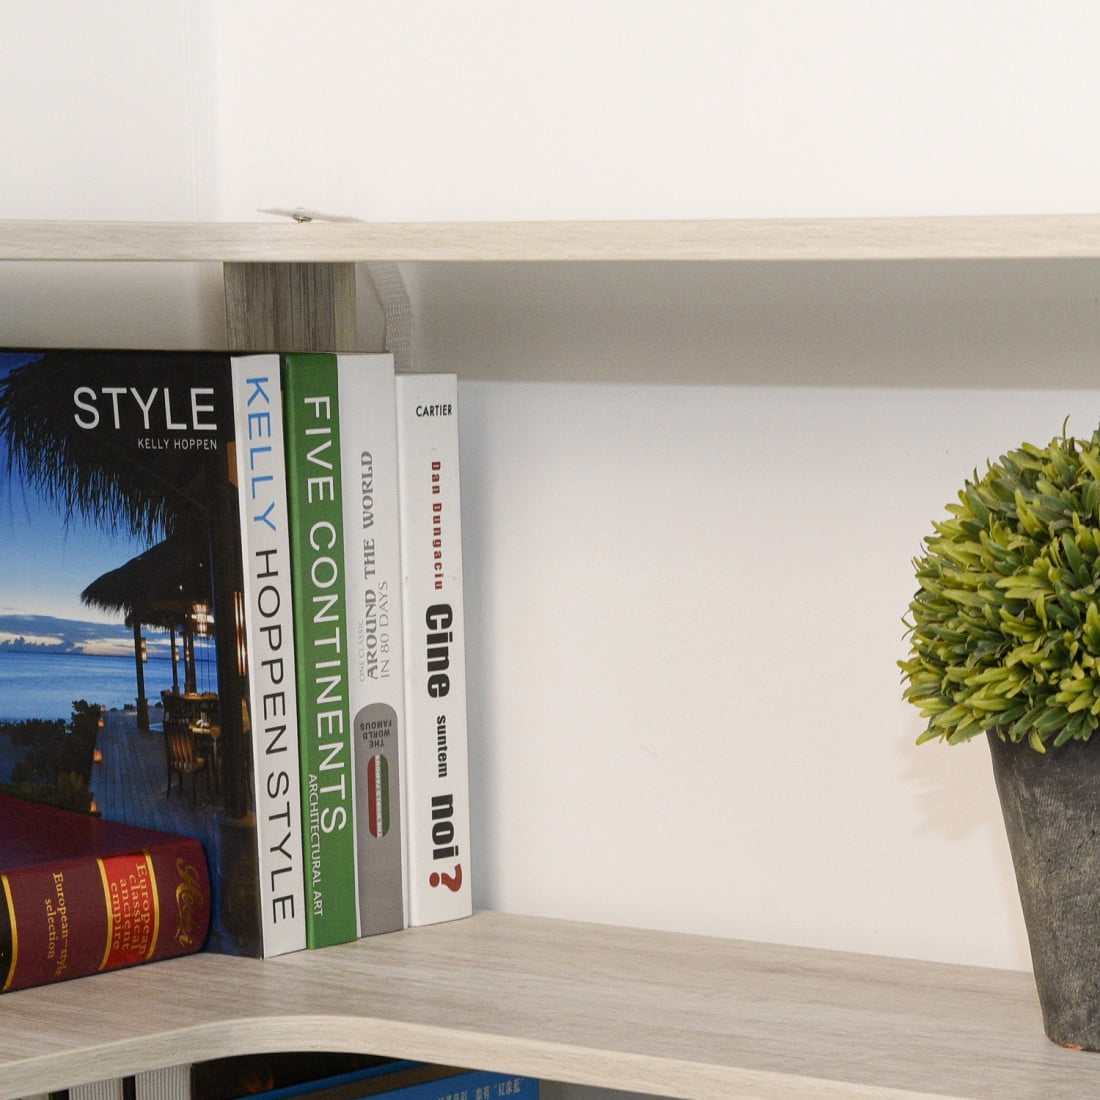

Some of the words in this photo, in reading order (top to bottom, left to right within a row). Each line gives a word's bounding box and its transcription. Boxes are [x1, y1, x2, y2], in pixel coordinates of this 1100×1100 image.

[73, 386, 217, 431] STYLE
[416, 404, 453, 417] CARTIER
[137, 438, 170, 450] KELLY
[173, 438, 217, 450] HOPPEN
[245, 376, 277, 532] KELLY
[304, 396, 335, 504] FIVE
[361, 451, 374, 529] WORLD
[431, 461, 441, 494] Dan
[363, 538, 376, 580] THE
[432, 503, 444, 590] Dungaciu
[365, 589, 378, 680] AROUND
[378, 581, 389, 627] DAYS
[255, 549, 288, 755] HOPPEN
[380, 633, 390, 654] 80
[380, 660, 390, 678] IN
[425, 603, 453, 699] Cine
[308, 520, 347, 834] CONTINENTS
[360, 719, 392, 730] FAMOUS
[363, 729, 390, 739] WORLD
[369, 739, 384, 748] THE
[436, 715, 448, 778] suntem
[267, 770, 295, 925] STYLE
[308, 773, 321, 888] ARCHITECTURAL
[45, 898, 58, 958] selection
[111, 882, 121, 950] empire
[120, 879, 131, 950] ancient
[129, 874, 141, 950] classical
[136, 863, 150, 956] European
[313, 890, 323, 917] ART
